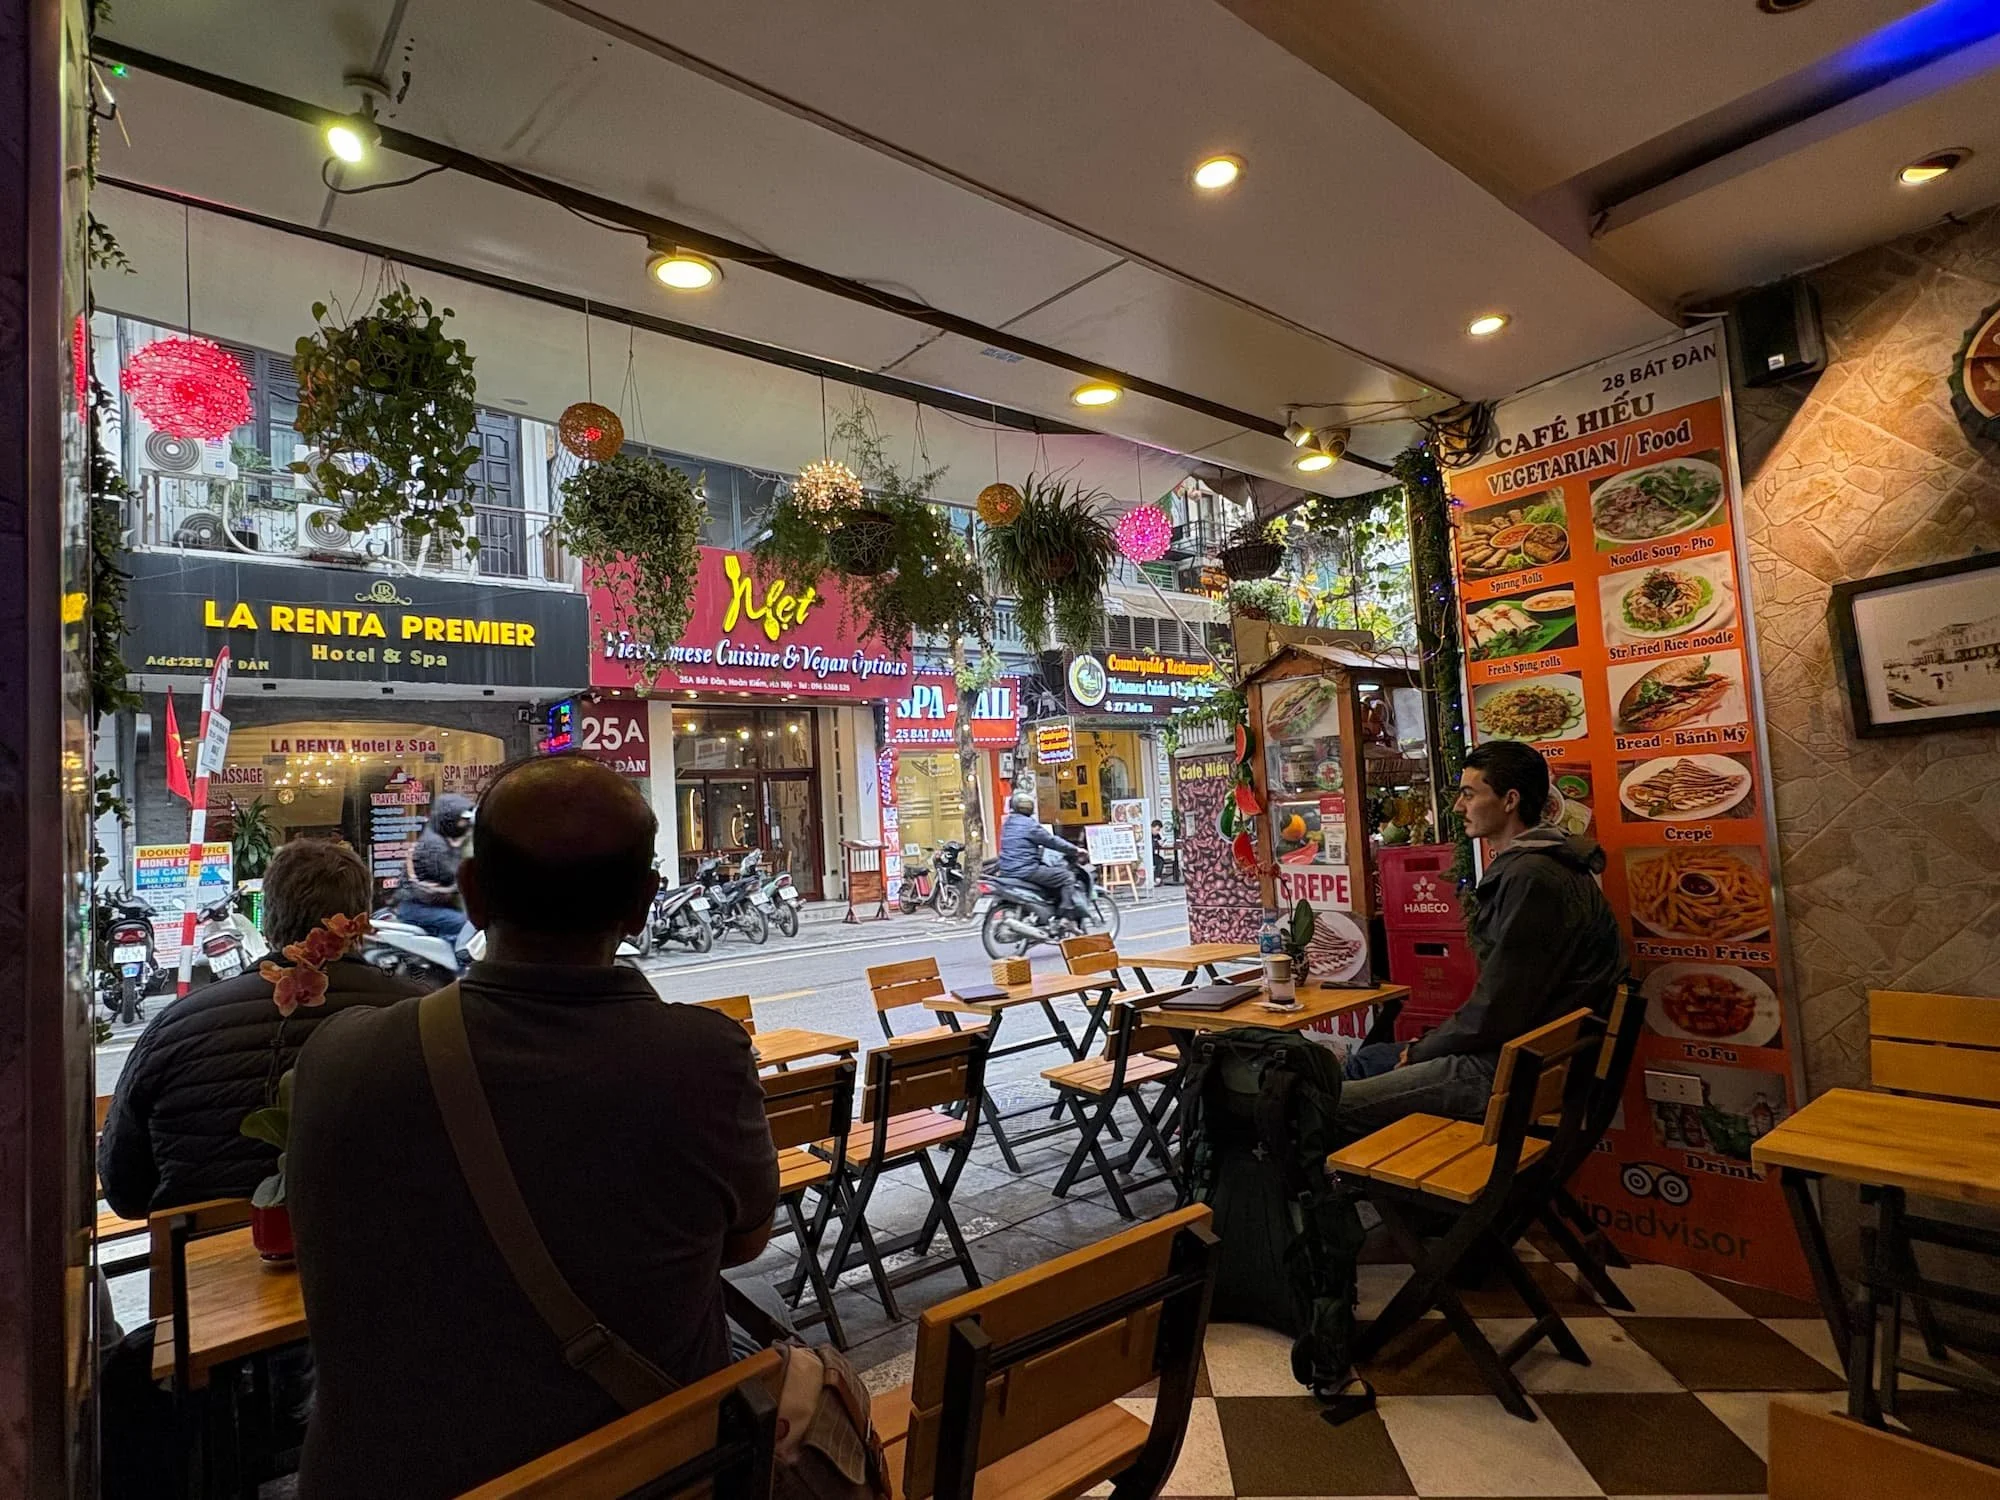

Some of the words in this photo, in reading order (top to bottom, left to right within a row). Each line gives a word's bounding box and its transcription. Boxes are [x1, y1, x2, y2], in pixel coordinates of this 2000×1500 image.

[1602, 373, 1625, 392] 28
[1630, 358, 1667, 384] BÁT
[1671, 343, 1717, 370] ĐÀN
[1495, 415, 1569, 458] CAFÉ
[1576, 390, 1654, 435] HIẾU
[1488, 441, 1618, 494] VEGETARIAN
[1622, 435, 1632, 465] /
[1637, 420, 1690, 455] Food
[1610, 550, 1649, 567] Noodle
[1651, 544, 1681, 559] Soup
[1691, 537, 1714, 550] Pho
[1521, 572, 1543, 586] Rolls
[204, 600, 258, 630] LA
[270, 605, 387, 639] RENTA
[401, 614, 536, 647] PREMIER
[312, 644, 375, 663] Hotel
[382, 647, 402, 664] &
[410, 649, 448, 669] Spa
[1609, 647, 1628, 660] Str
[1630, 641, 1660, 657] Fried
[1664, 638, 1689, 652] Rice
[1692, 631, 1734, 647] noodle
[716, 638, 780, 668] Cuisine
[783, 644, 800, 670] &
[800, 645, 848, 679] Vegan
[1108, 653, 1165, 676] Countryside
[1487, 663, 1511, 675] Fresh
[1540, 656, 1561, 668] rolls
[971, 687, 1014, 719] AIL
[581, 716, 645, 751] 25A
[895, 728, 908, 739] 25
[1615, 734, 1661, 752] Bread
[1674, 729, 1717, 745] Bánh
[270, 739, 290, 753] LA
[296, 739, 345, 753] RENTA
[352, 740, 390, 752] Hotel
[395, 740, 404, 752] &
[409, 740, 436, 753] Spa
[443, 765, 461, 780] SPA
[371, 793, 398, 805] TRAVEL
[140, 858, 175, 868] MONEY
[140, 868, 159, 877] SIM
[1280, 872, 1349, 904] CREPE
[1403, 902, 1449, 914] HABECO
[1634, 941, 1709, 960] French
[1715, 945, 1771, 962] Fries
[1682, 1043, 1738, 1063] ToFu
